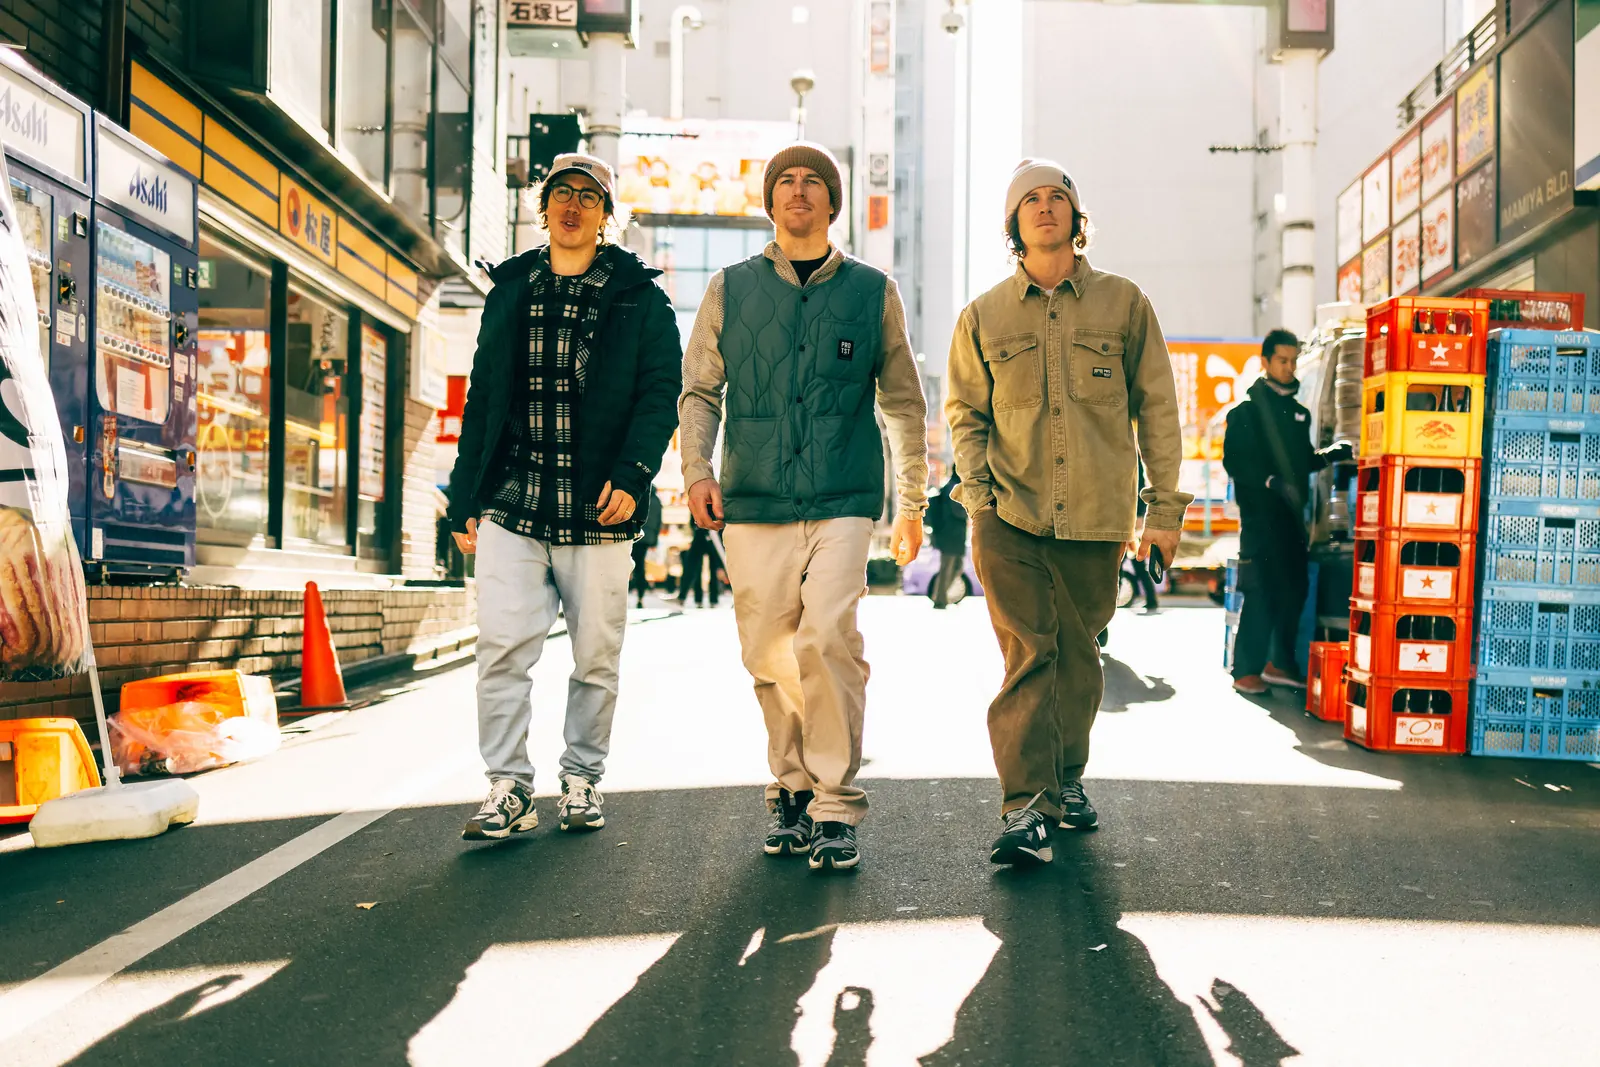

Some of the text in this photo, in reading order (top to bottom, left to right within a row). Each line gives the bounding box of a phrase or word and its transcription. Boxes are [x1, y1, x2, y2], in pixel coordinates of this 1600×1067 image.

[511, 2, 574, 22] 石塚ビ
[0, 85, 48, 147] Asahi
[129, 164, 168, 215] Asahi
[304, 203, 331, 257] 松屋
[1555, 334, 1591, 345] NIGITA
